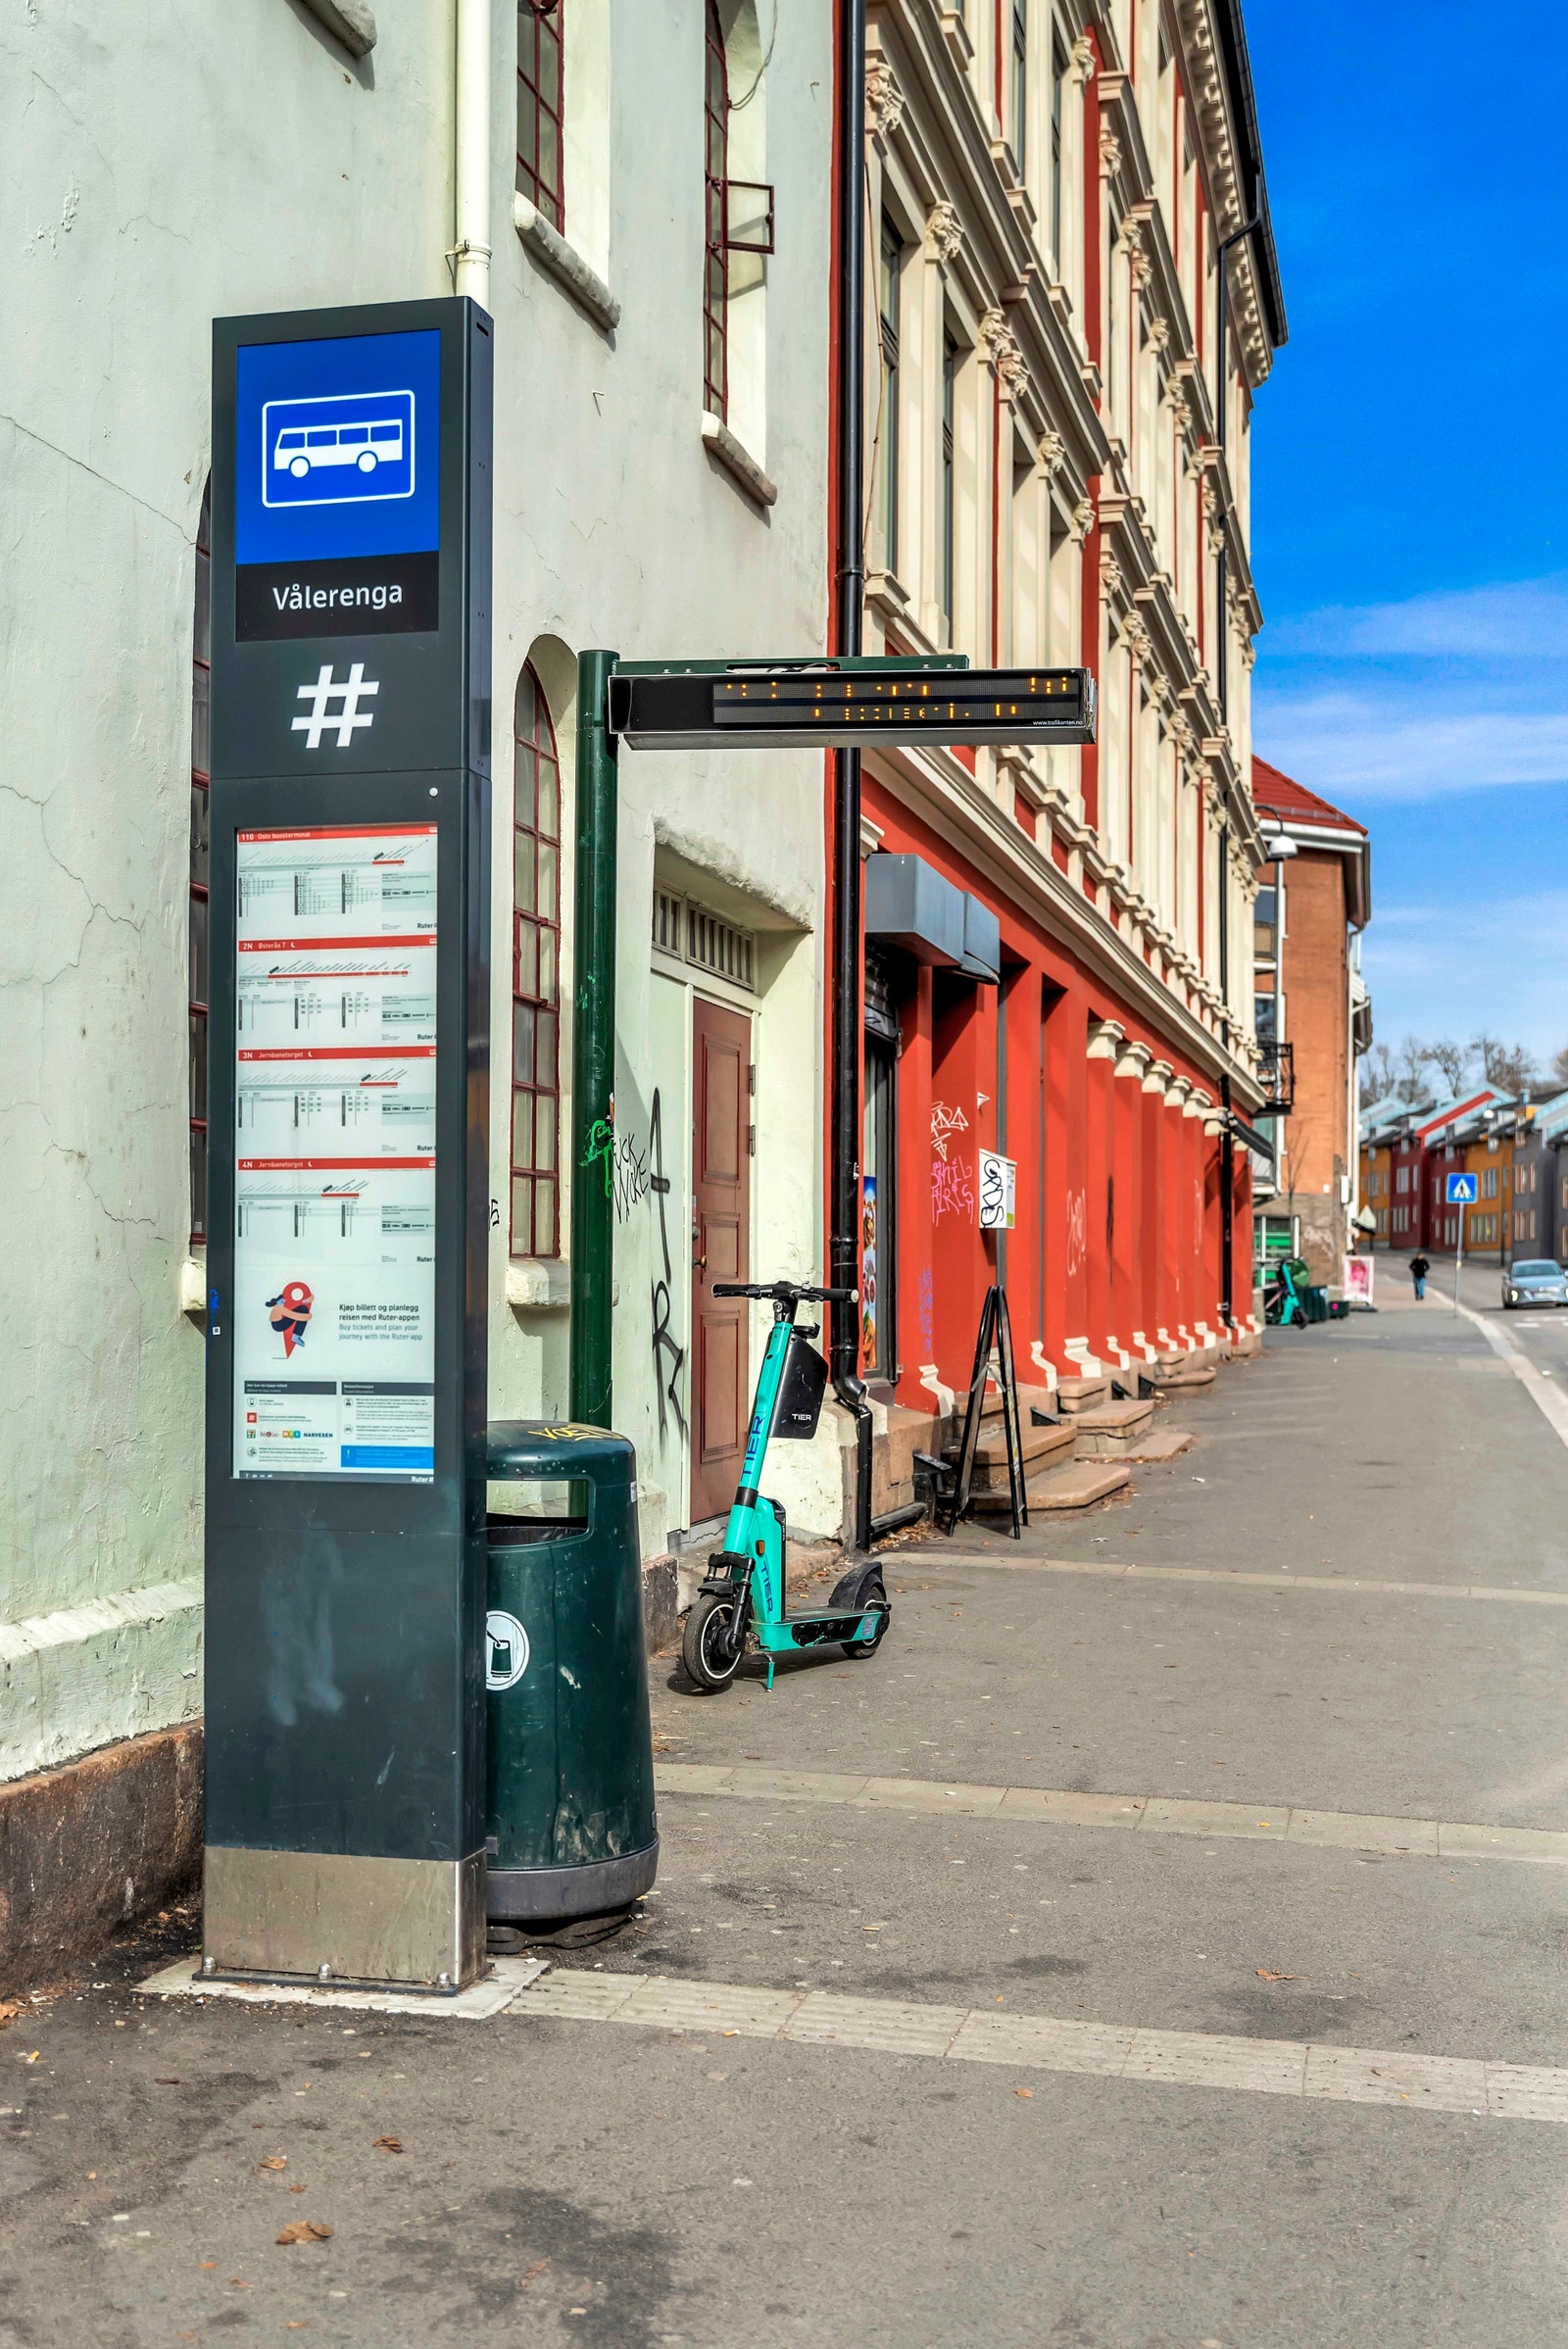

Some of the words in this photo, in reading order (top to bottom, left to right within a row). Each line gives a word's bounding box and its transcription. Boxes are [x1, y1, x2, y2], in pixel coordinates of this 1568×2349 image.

[272, 584, 403, 611] Vålerenga
[740, 1416, 763, 1482] TIER
[761, 1560, 774, 1612] TIER
